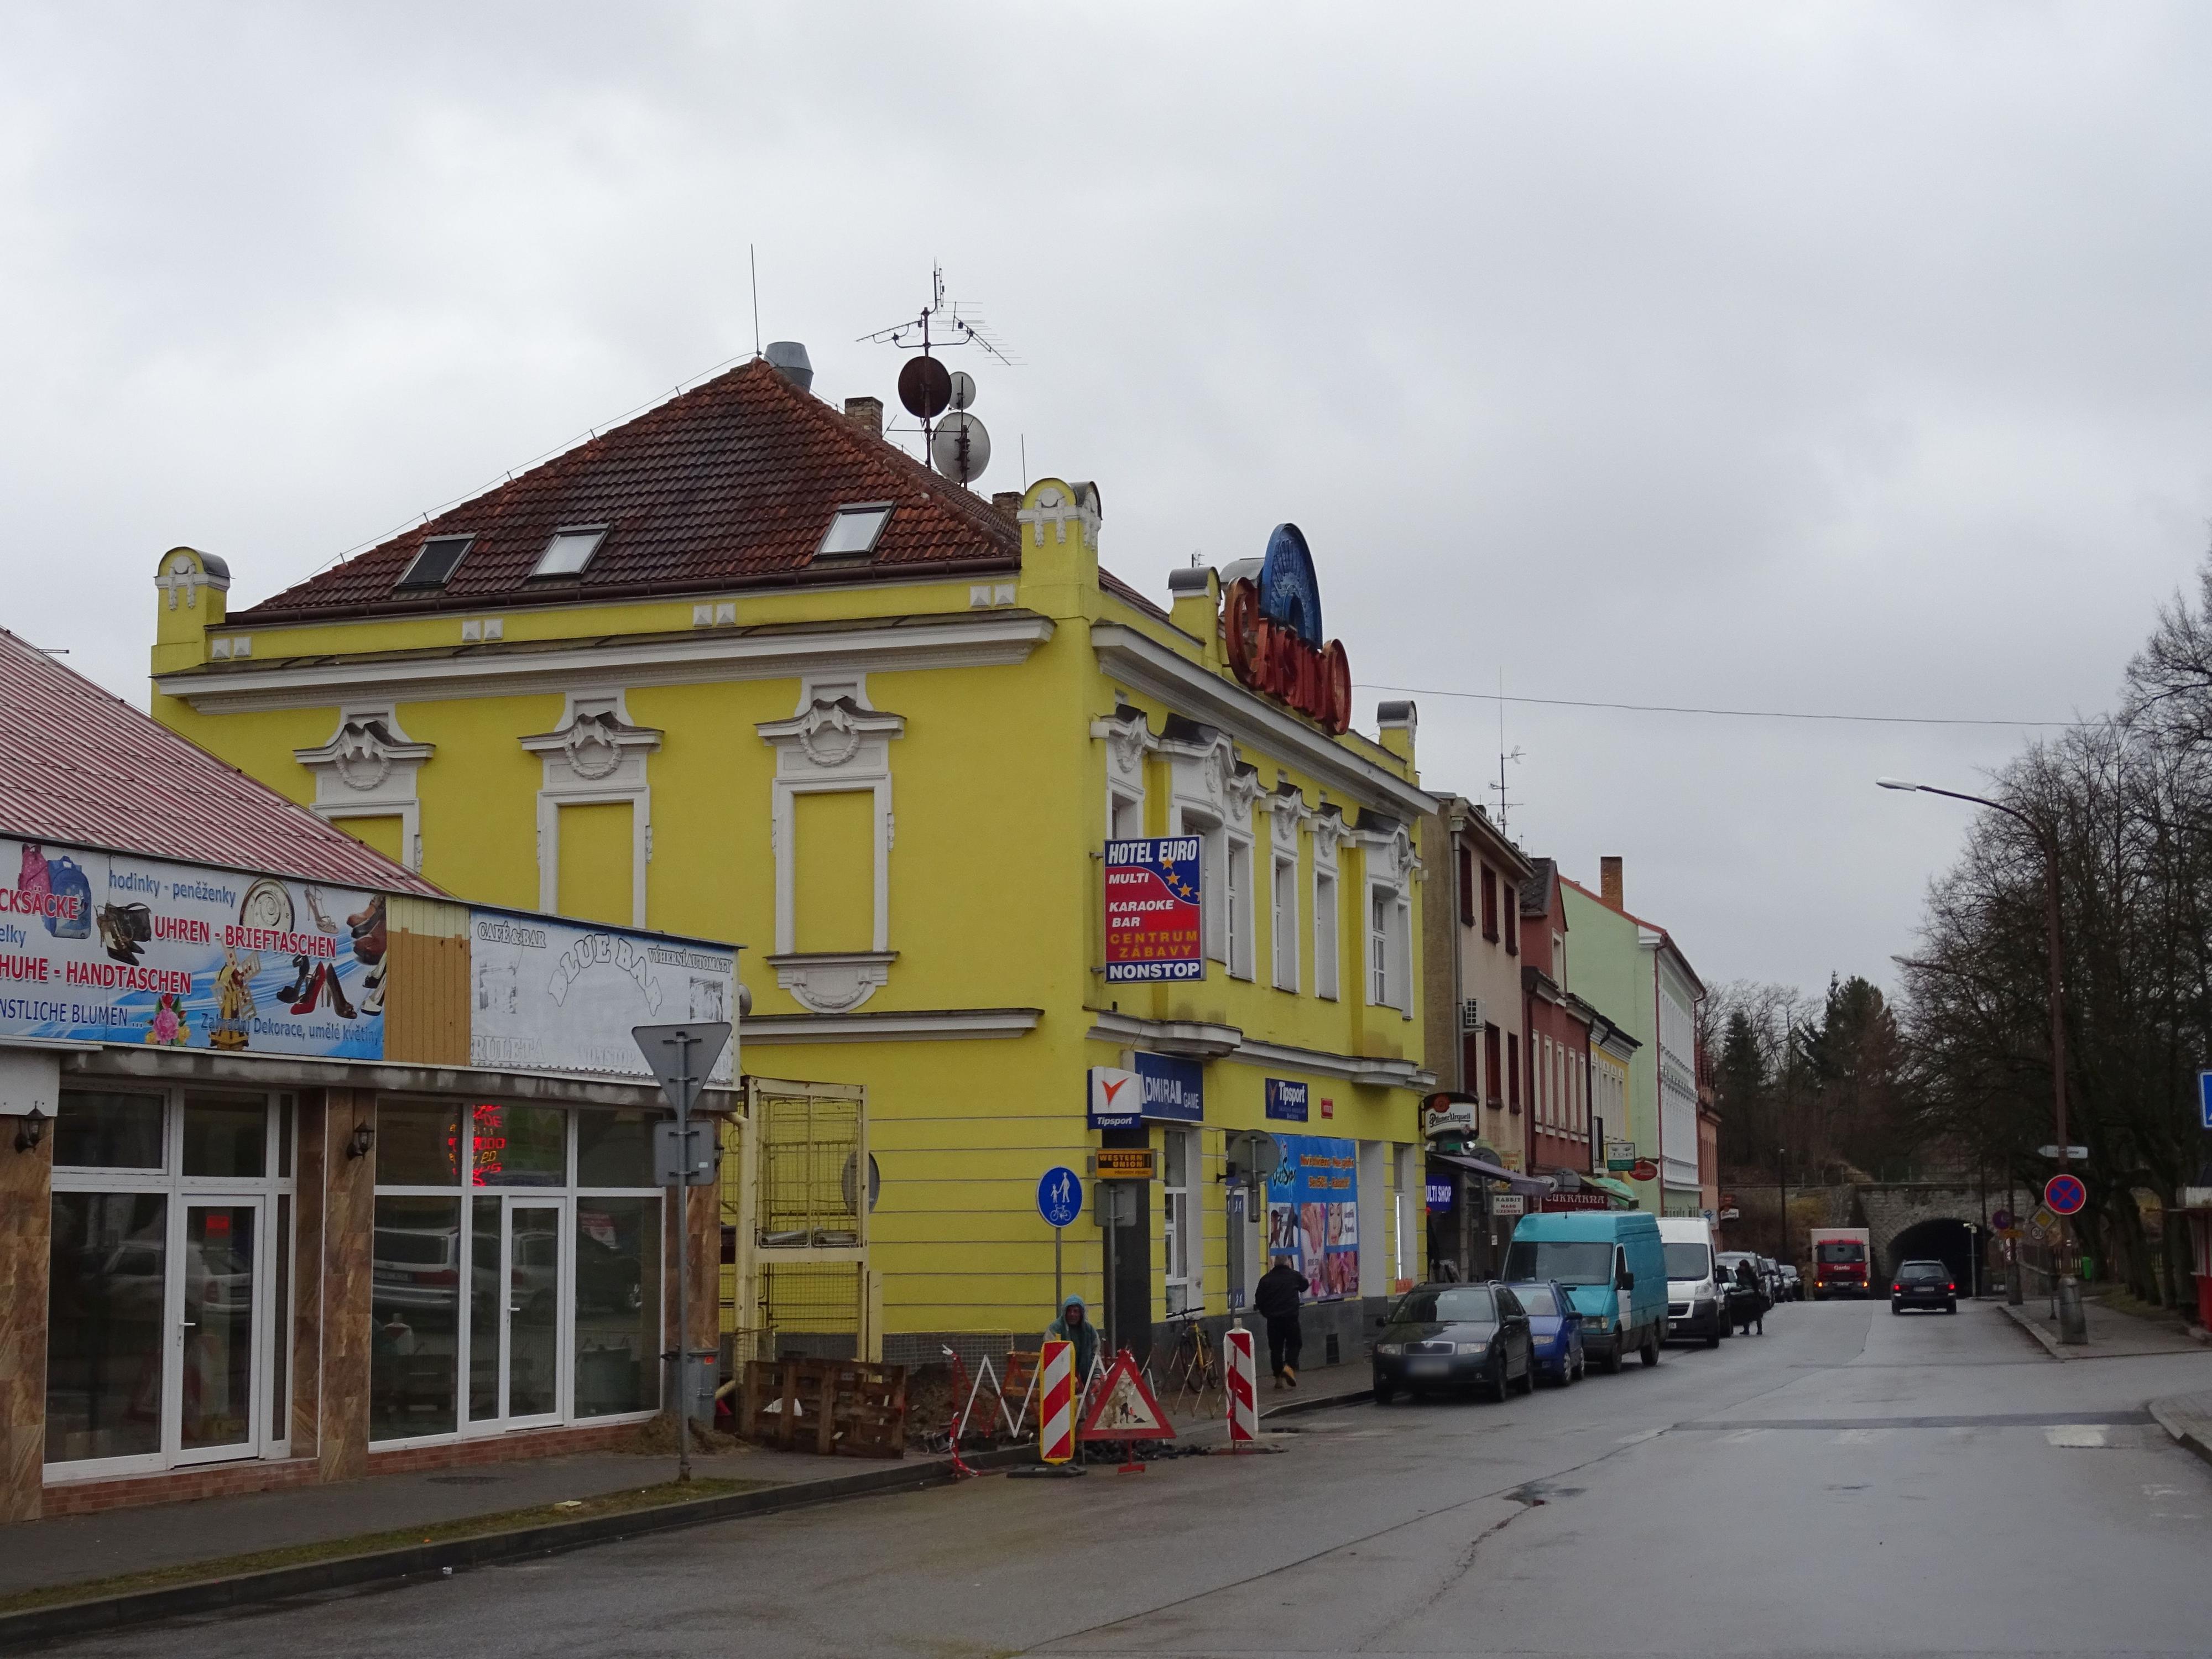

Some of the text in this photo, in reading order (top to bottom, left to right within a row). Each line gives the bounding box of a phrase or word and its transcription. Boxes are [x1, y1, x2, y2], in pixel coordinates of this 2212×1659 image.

[1108, 839, 1197, 864] HOTEL EURO
[109, 869, 160, 896] hodinky
[173, 880, 236, 908] peněženky
[1109, 873, 1149, 884] MULTI
[0, 885, 79, 920] CKSÄCKE
[1109, 900, 1175, 912] KARAOKE
[1112, 917, 1141, 927] BAR
[0, 924, 26, 947] elky
[155, 915, 210, 943] UHREN
[225, 925, 336, 958] BRIEFTASCHEN
[477, 920, 546, 948] CAFÉ & BAR
[1110, 930, 1198, 945] CENTRUM
[648, 945, 732, 973] VÝHERNÍ AUTOMATY
[1119, 943, 1192, 958] ZÁBAVY
[0, 954, 48, 981] HUHE
[66, 961, 191, 994] HANDTASCHEN
[547, 933, 662, 1016] BLUE BAR
[1109, 963, 1199, 979] NONSTOP
[0, 998, 66, 1022] NSTLICHE
[72, 1004, 128, 1026] BLUMEN
[253, 1017, 305, 1040] Dekorace,
[309, 1023, 340, 1040] umělé
[472, 1035, 545, 1063] RULETA
[1183, 1092, 1199, 1109] GAME
[1279, 1081, 1305, 1106] Tipsport
[1097, 1117, 1133, 1126] Tipsport
[1430, 1112, 1471, 1128] Pilsner Urquell
[1438, 1185, 1452, 1202] SHOP
